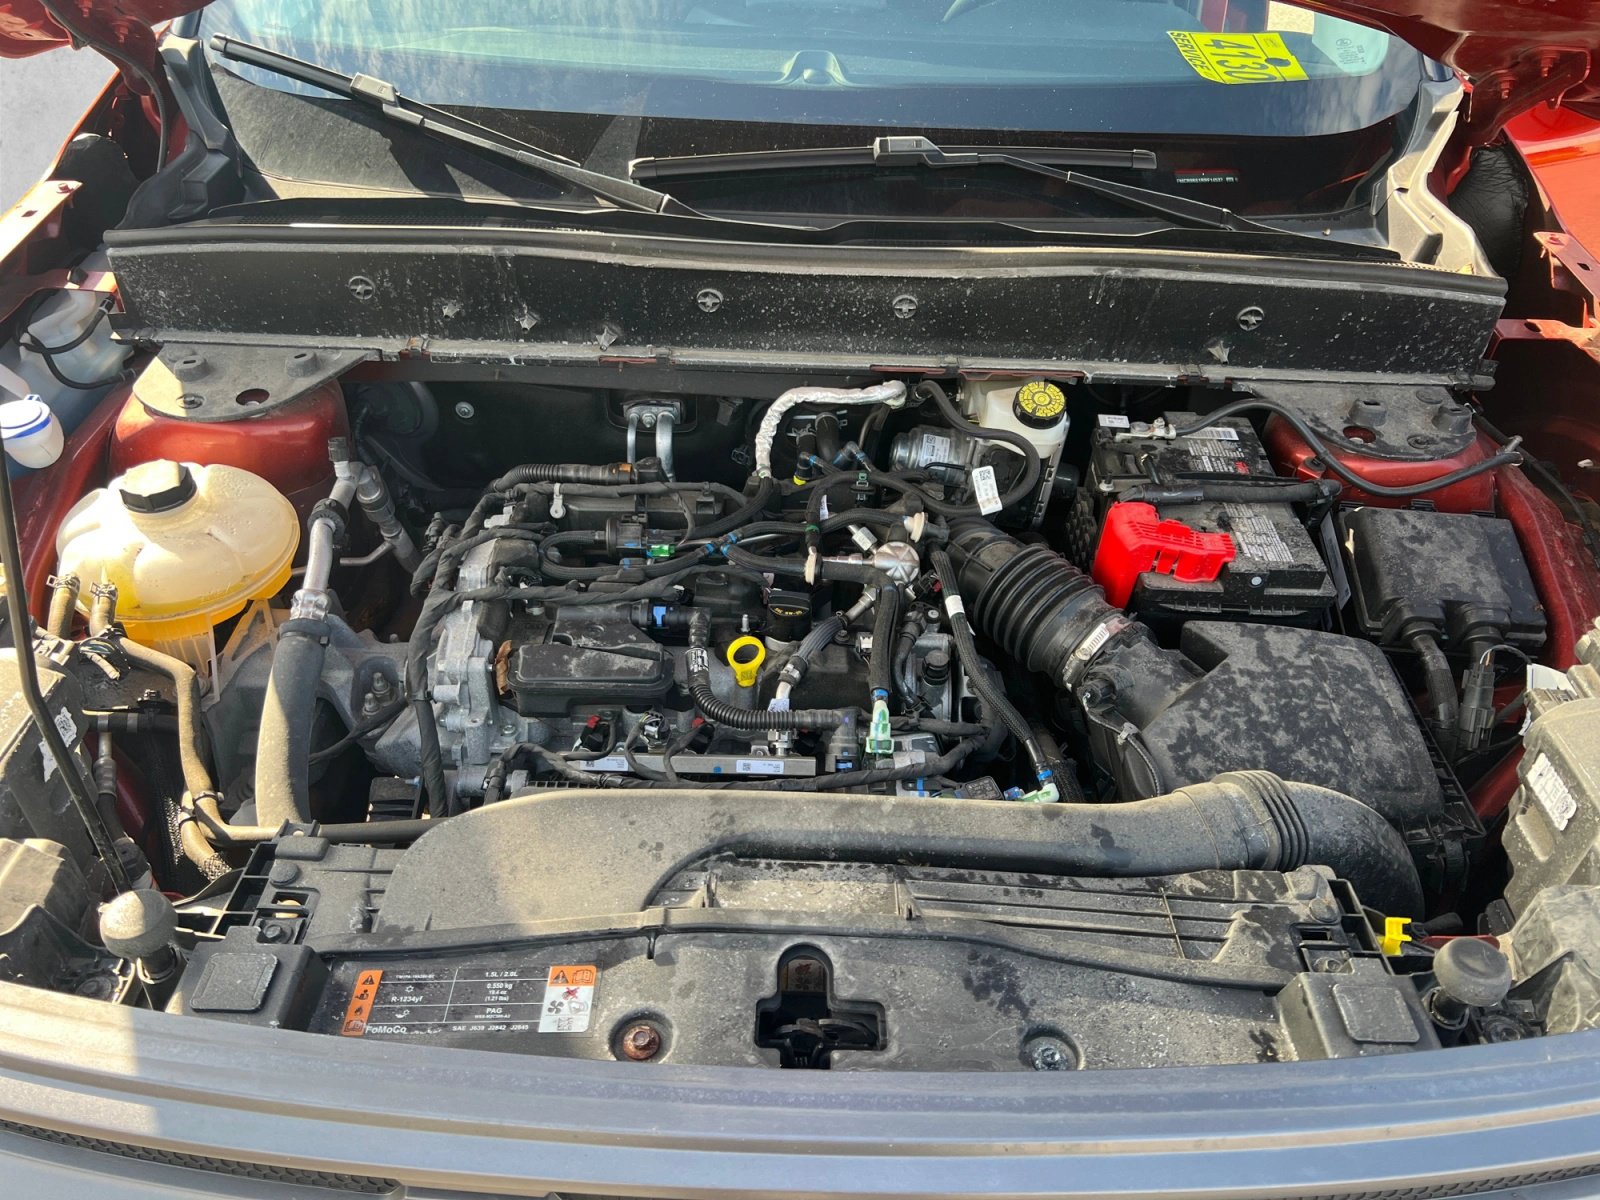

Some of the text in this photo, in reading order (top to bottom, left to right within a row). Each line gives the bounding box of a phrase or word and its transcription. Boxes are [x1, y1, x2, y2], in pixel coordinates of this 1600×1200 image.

[1171, 32, 1211, 71] SERVICE
[1204, 39, 1277, 81] 4130
[504, 982, 513, 990] kg
[391, 995, 424, 1003] R-1234yf
[365, 1025, 408, 1034] FoMoCo
